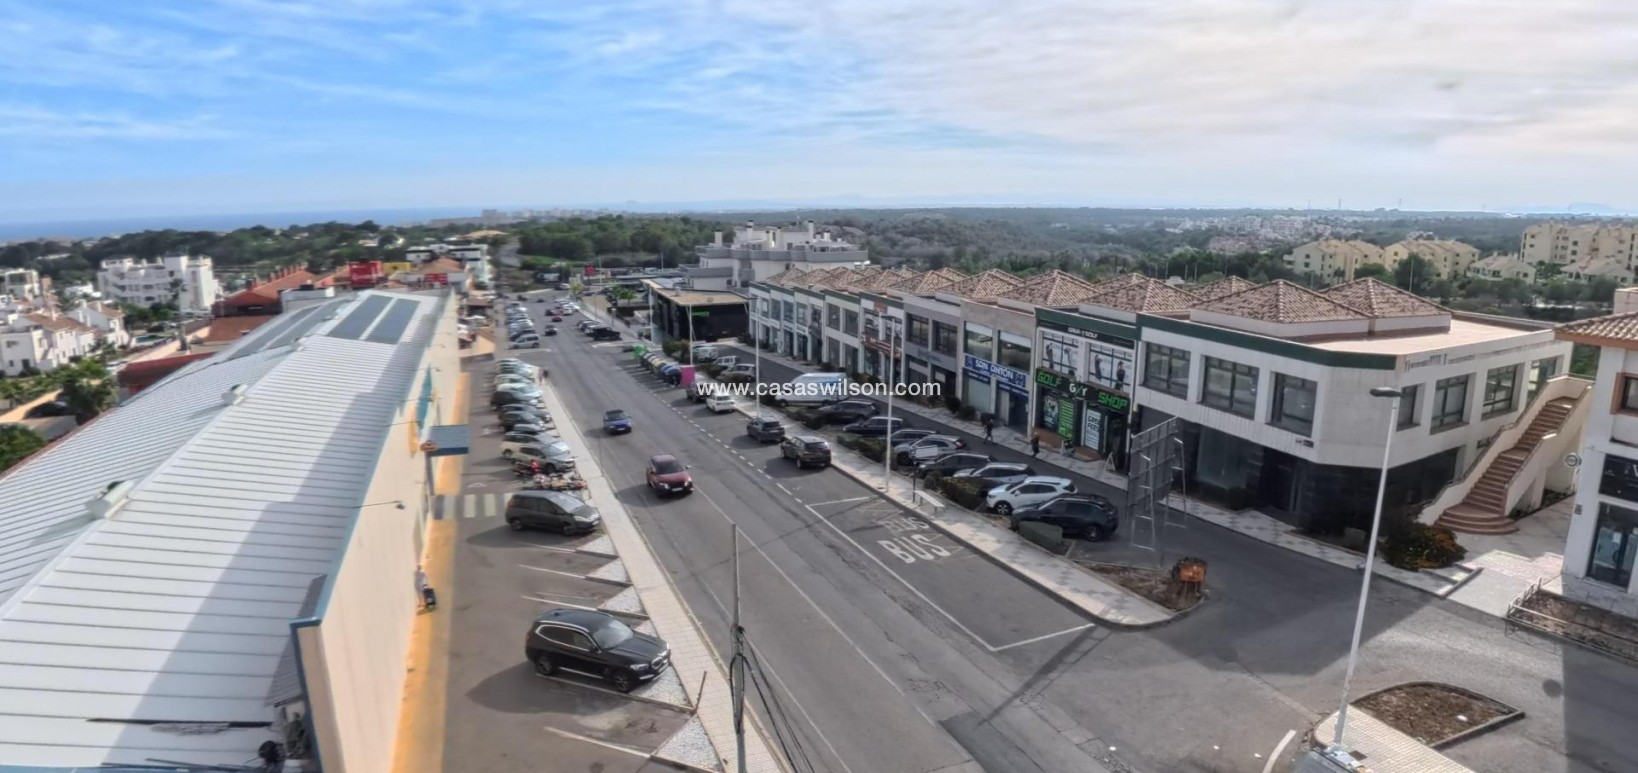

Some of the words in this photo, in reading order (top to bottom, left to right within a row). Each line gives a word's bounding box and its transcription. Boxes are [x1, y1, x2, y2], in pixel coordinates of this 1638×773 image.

[1037, 371, 1061, 388] GOLF
[1098, 391, 1128, 411] SHOP
[877, 534, 951, 564] BUS
